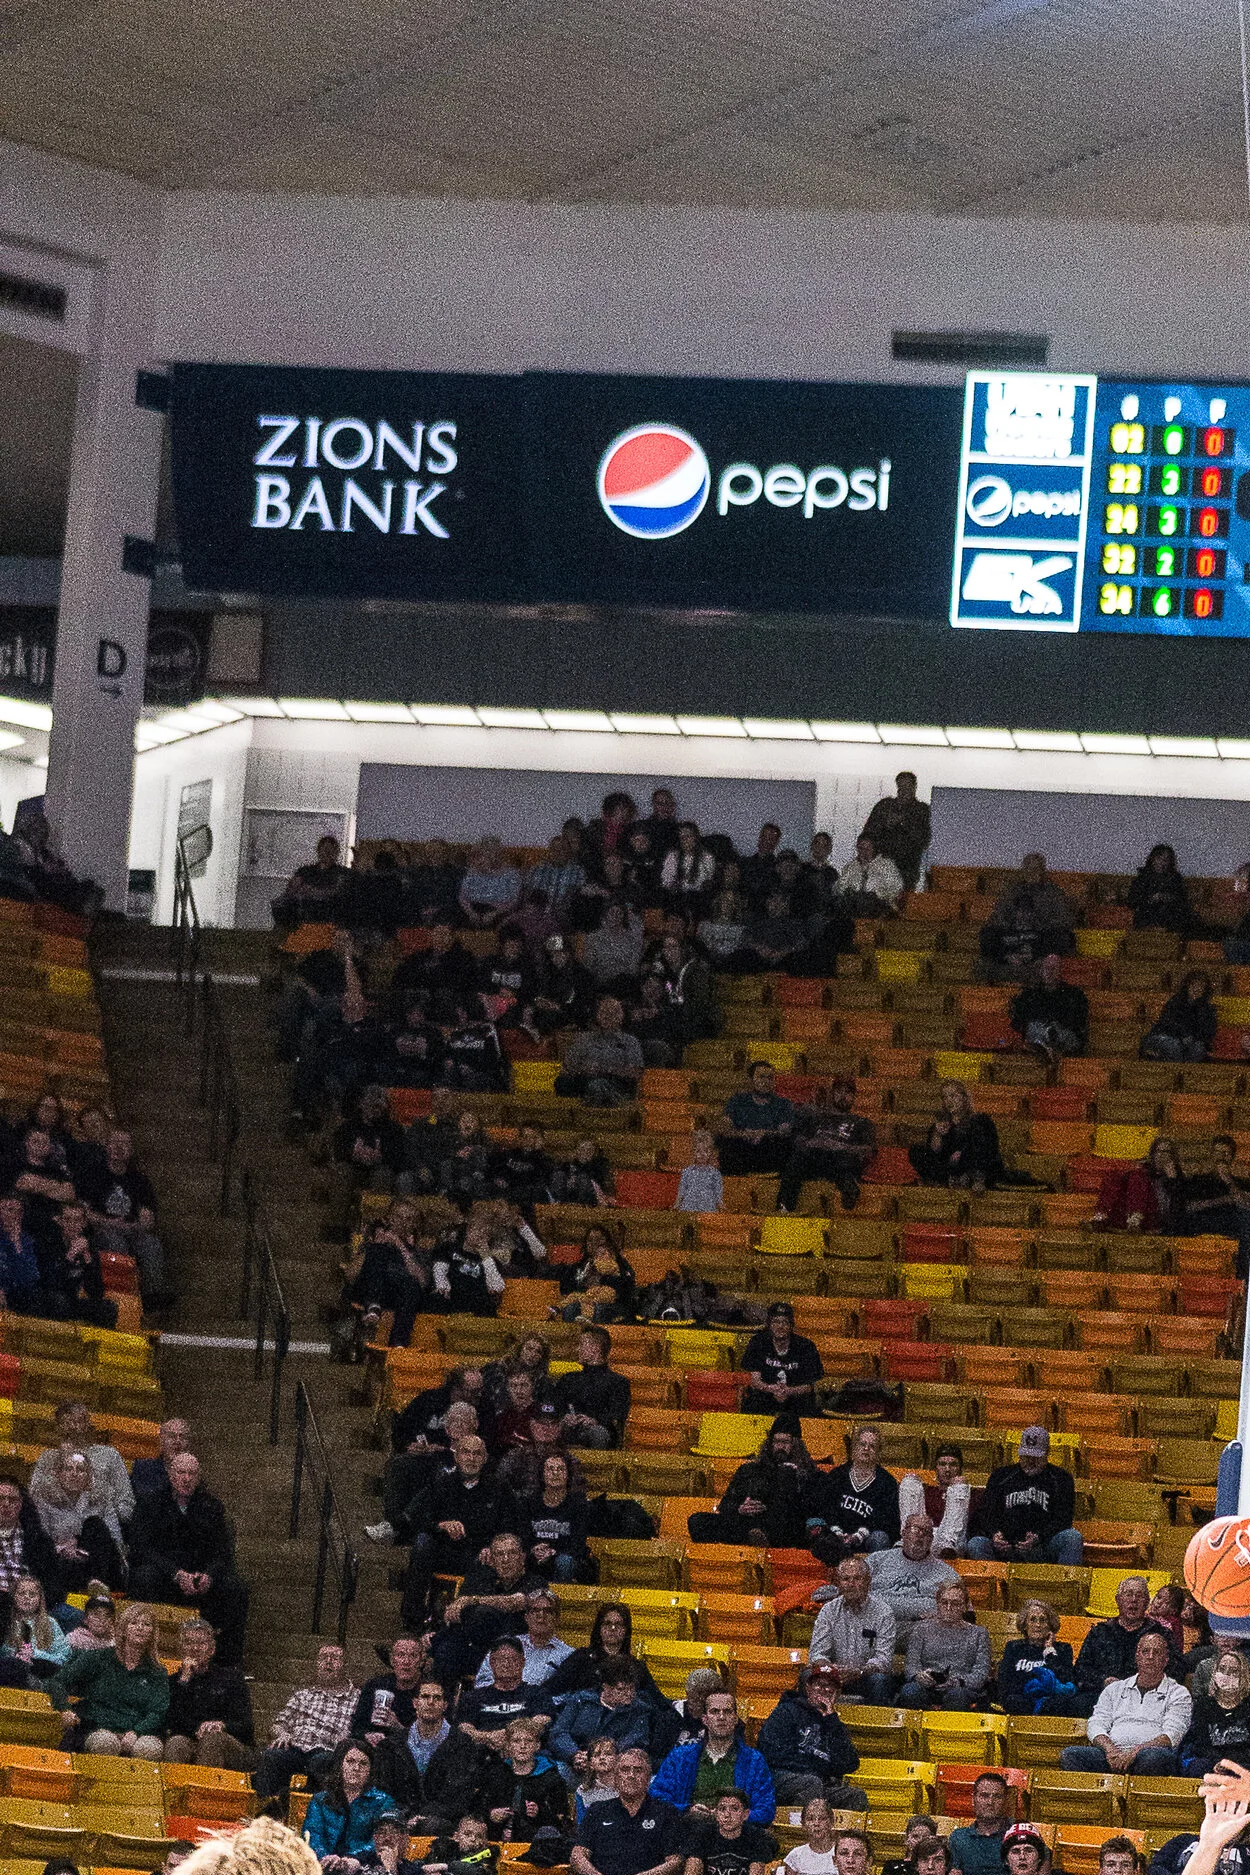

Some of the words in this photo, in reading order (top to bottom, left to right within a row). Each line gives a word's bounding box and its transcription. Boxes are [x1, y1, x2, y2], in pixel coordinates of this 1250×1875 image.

[253, 415, 458, 474] ZIONS
[1204, 426, 1224, 456] 0
[717, 459, 892, 520] pepsi
[1108, 462, 1142, 494] 22
[1201, 465, 1221, 496] 0
[252, 476, 450, 539] BANK
[1105, 502, 1138, 534] 24
[1199, 507, 1219, 537] 0
[1103, 542, 1136, 574] 32
[1155, 545, 1175, 576] 2
[1196, 547, 1216, 577] 0
[1100, 582, 1133, 614] 34
[1193, 587, 1213, 617] 0
[97, 638, 127, 678] D
